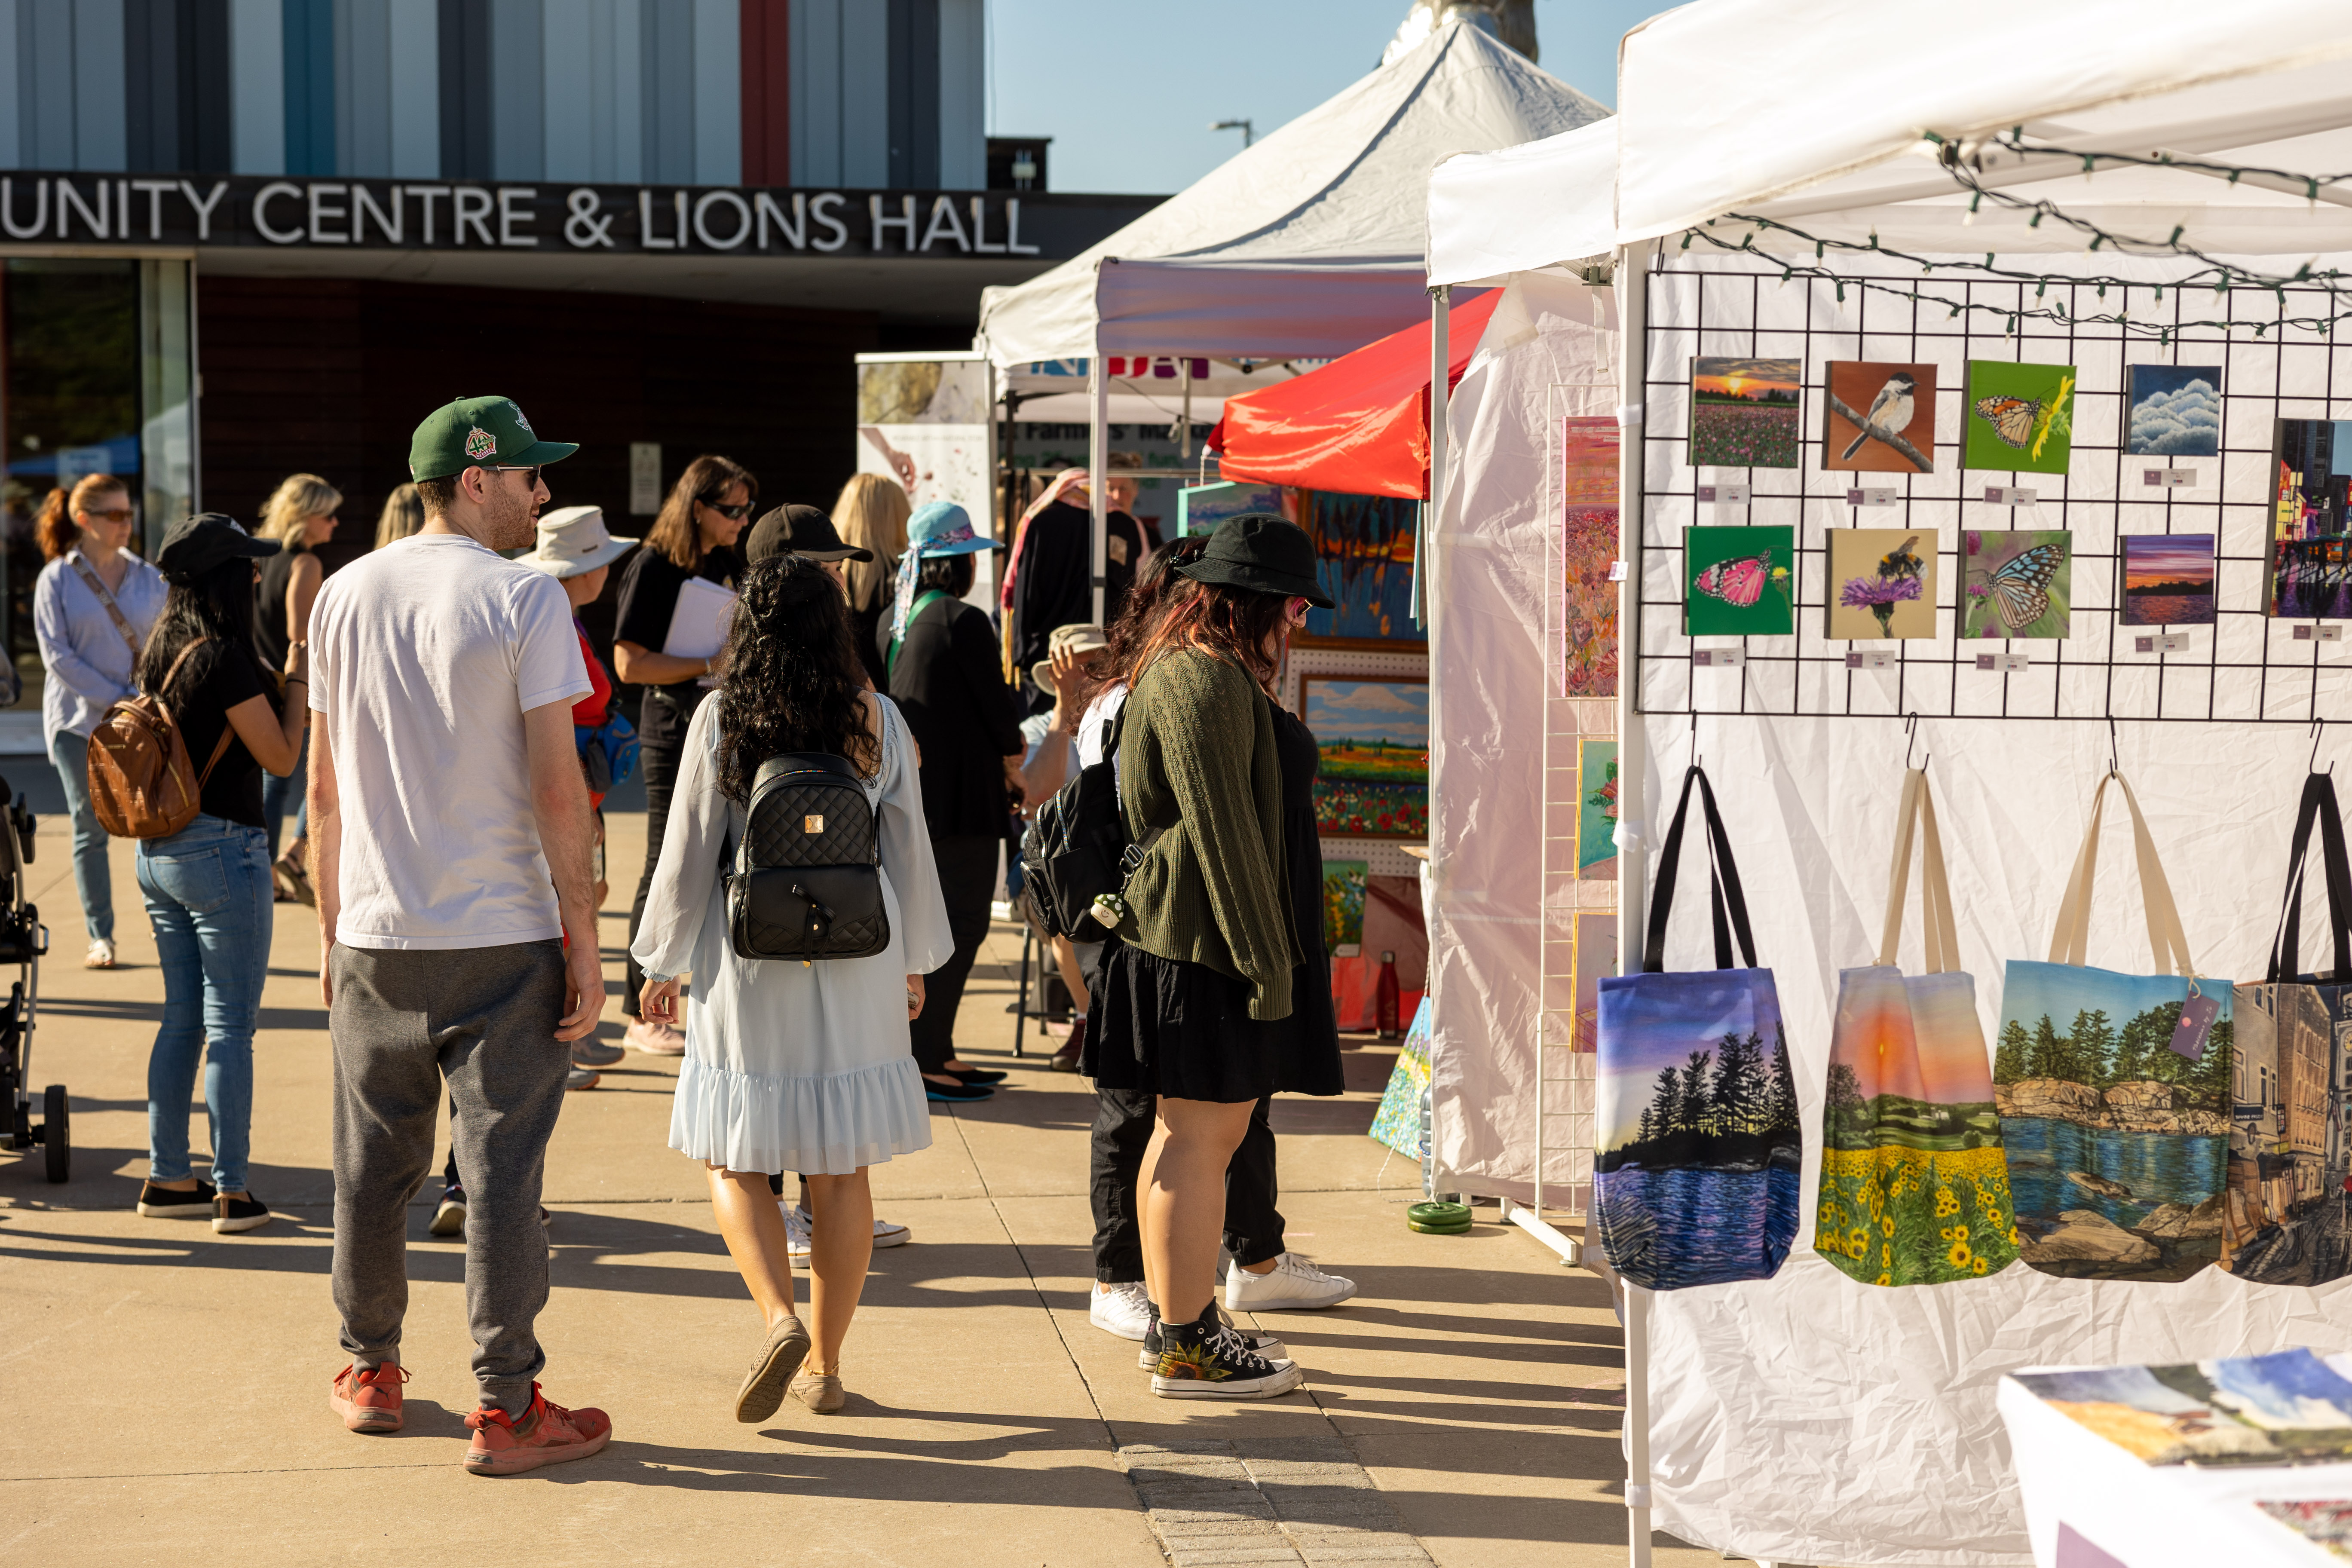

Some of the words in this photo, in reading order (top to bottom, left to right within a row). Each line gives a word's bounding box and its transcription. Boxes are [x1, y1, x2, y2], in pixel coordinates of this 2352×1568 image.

[1, 179, 229, 240] UNITY
[253, 183, 538, 246] CENTRE
[564, 188, 615, 248] &
[639, 190, 848, 252] LIONS
[869, 194, 1040, 254] HALL
